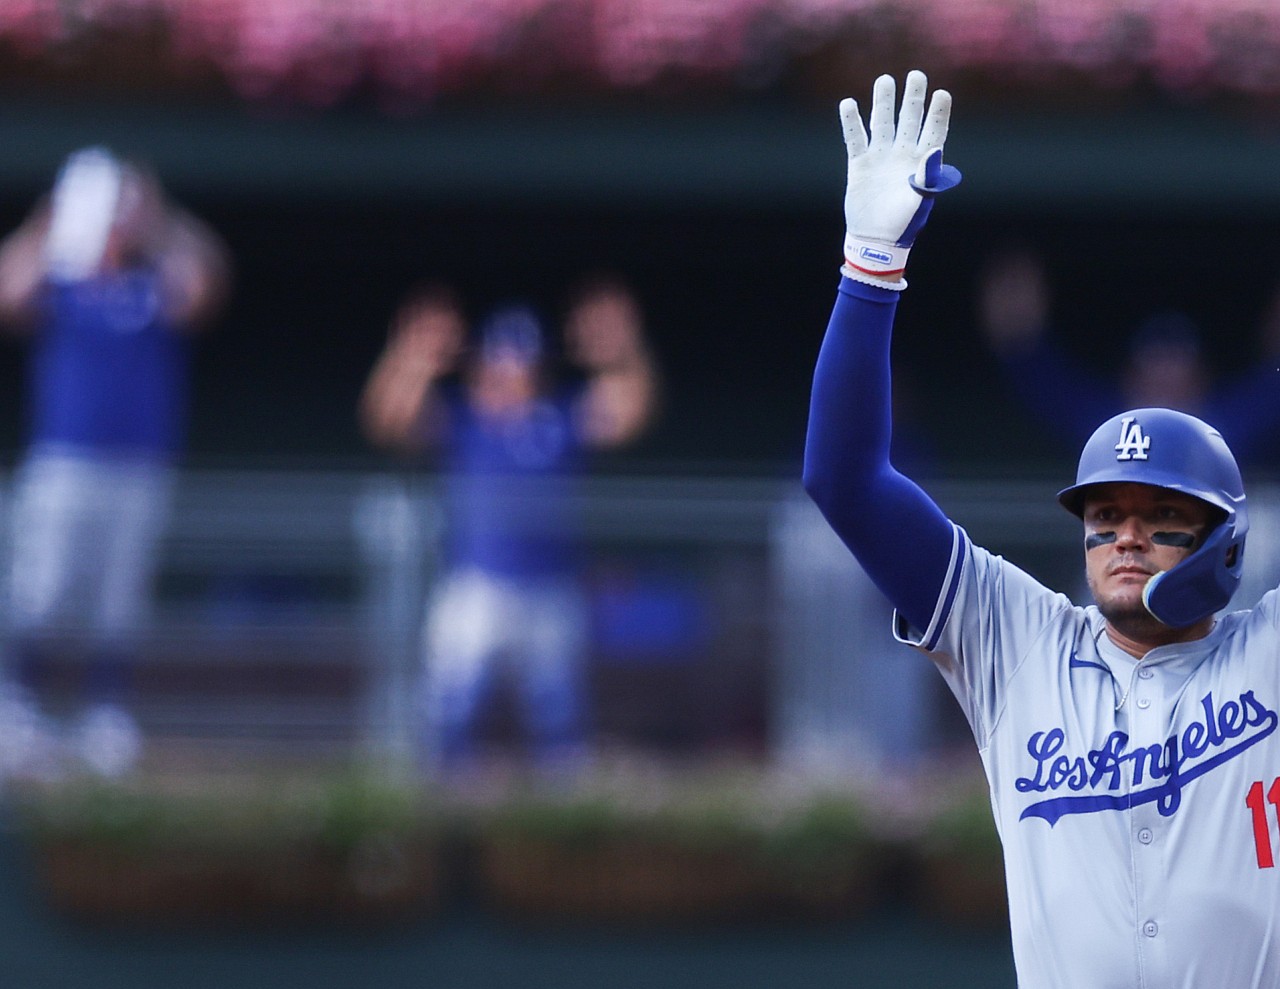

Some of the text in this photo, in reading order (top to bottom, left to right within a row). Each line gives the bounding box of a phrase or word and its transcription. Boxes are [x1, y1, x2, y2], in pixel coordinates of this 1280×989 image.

[1115, 416, 1151, 460] LA
[1014, 690, 1279, 817] Los Angeles
